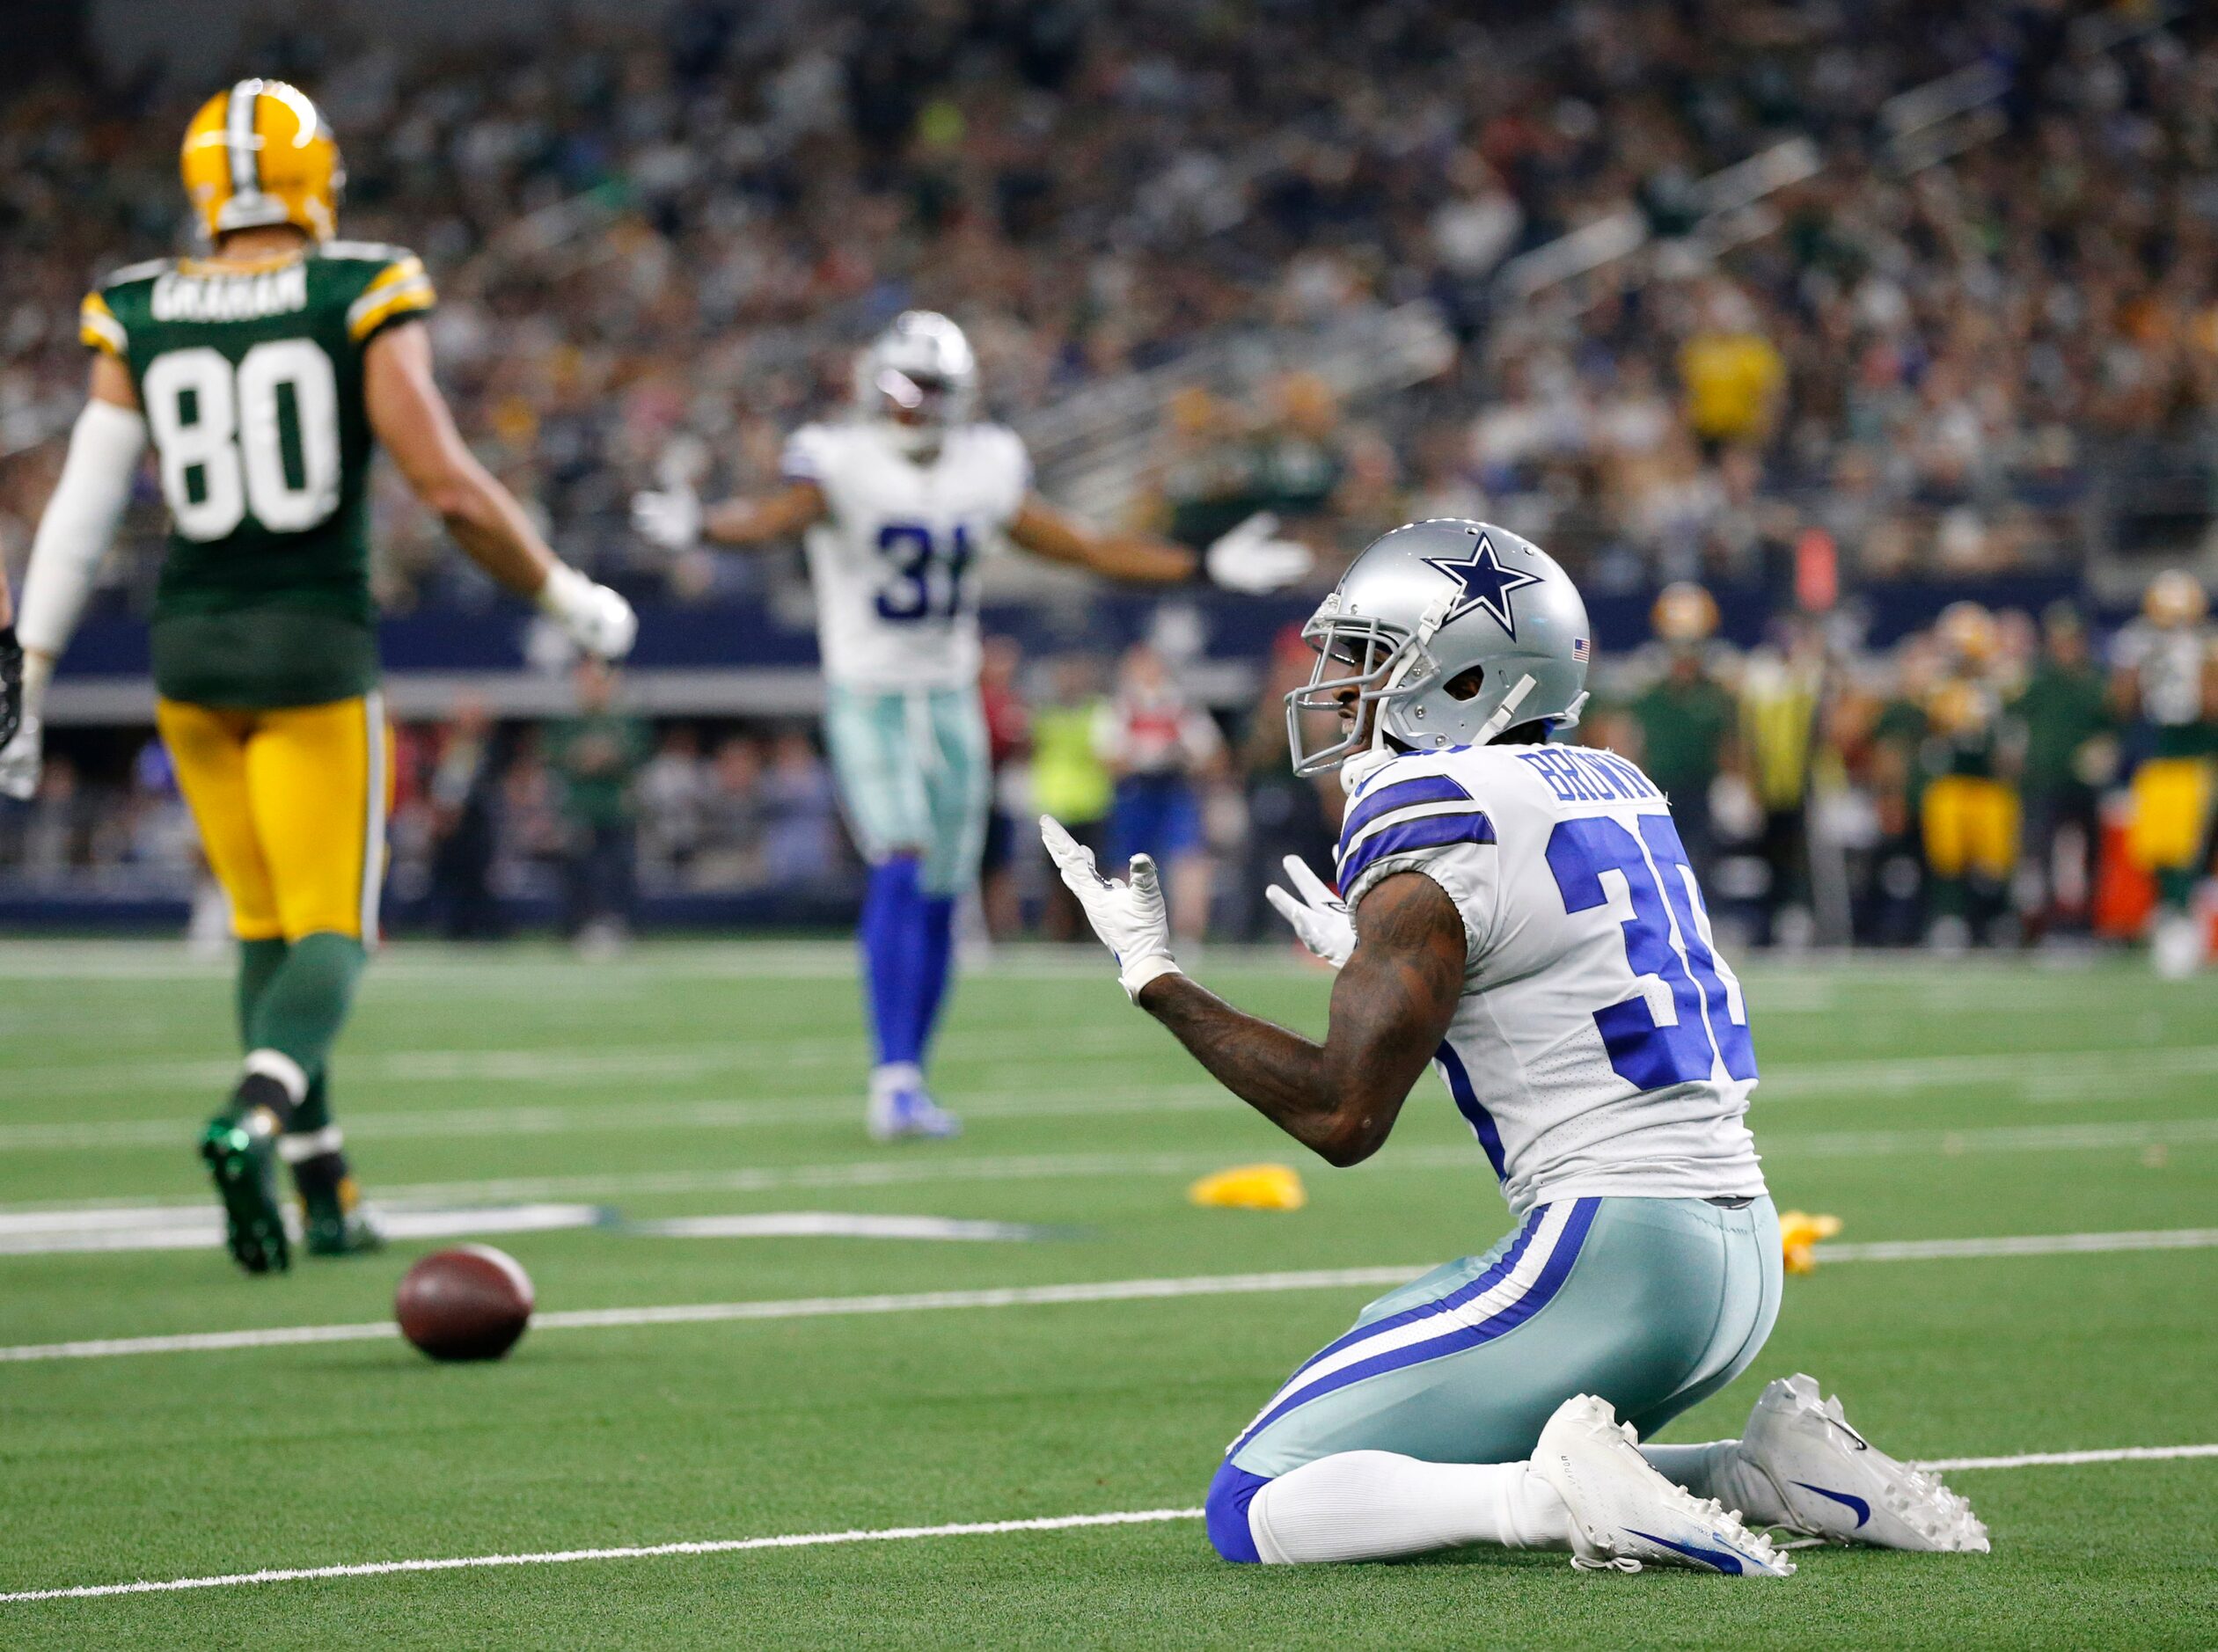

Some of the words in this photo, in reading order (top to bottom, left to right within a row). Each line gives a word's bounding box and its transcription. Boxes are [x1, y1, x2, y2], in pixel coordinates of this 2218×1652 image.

[151, 267, 307, 323] GRAHAM
[142, 337, 341, 544] 80
[876, 524, 968, 621] 31
[1516, 748, 1656, 801] BROWN
[1545, 814, 1759, 1091] 30
[1561, 1455, 1576, 1485] VAPOR
